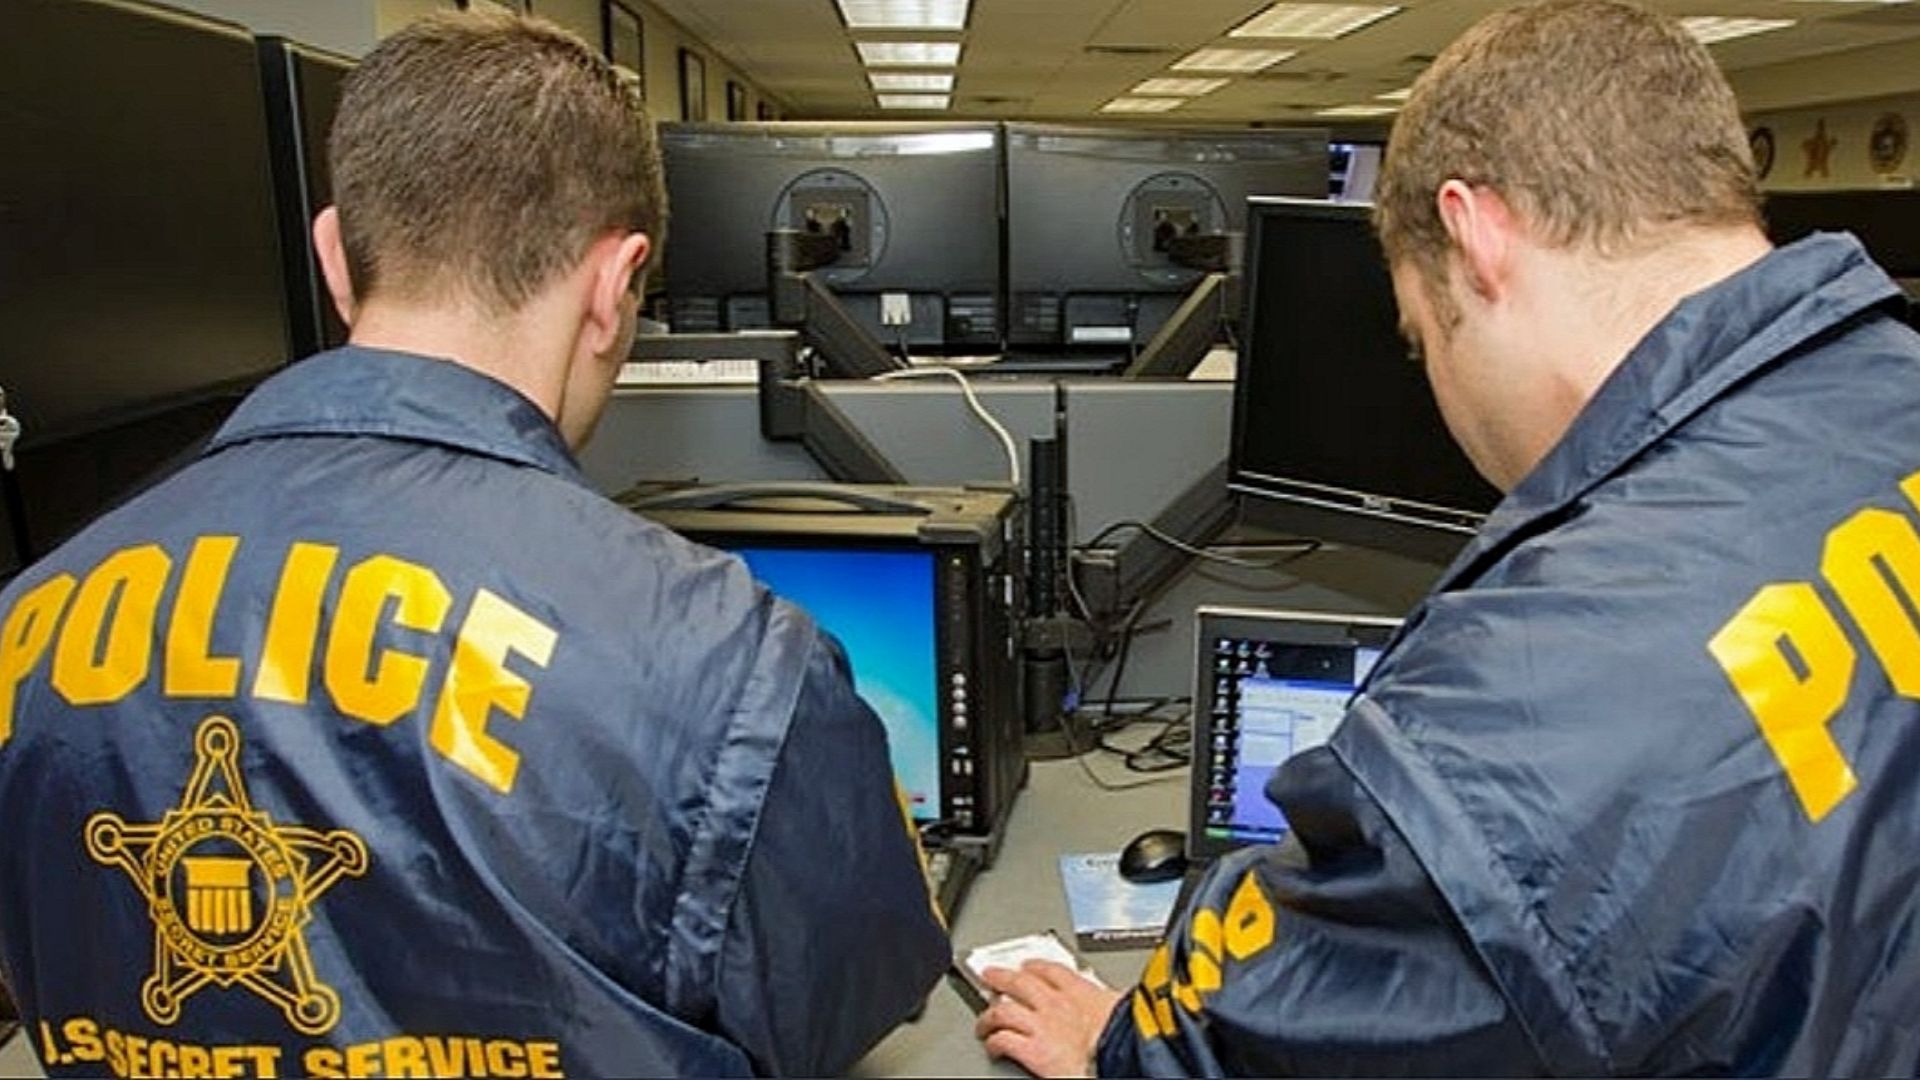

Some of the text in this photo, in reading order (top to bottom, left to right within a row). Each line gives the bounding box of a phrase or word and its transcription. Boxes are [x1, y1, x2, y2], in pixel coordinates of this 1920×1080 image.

[0, 535, 559, 793] POLICE
[1707, 470, 1920, 823] PO
[220, 818, 289, 877] STATES
[106, 1030, 281, 1078] SECRET
[304, 1037, 563, 1078] SERVICE
